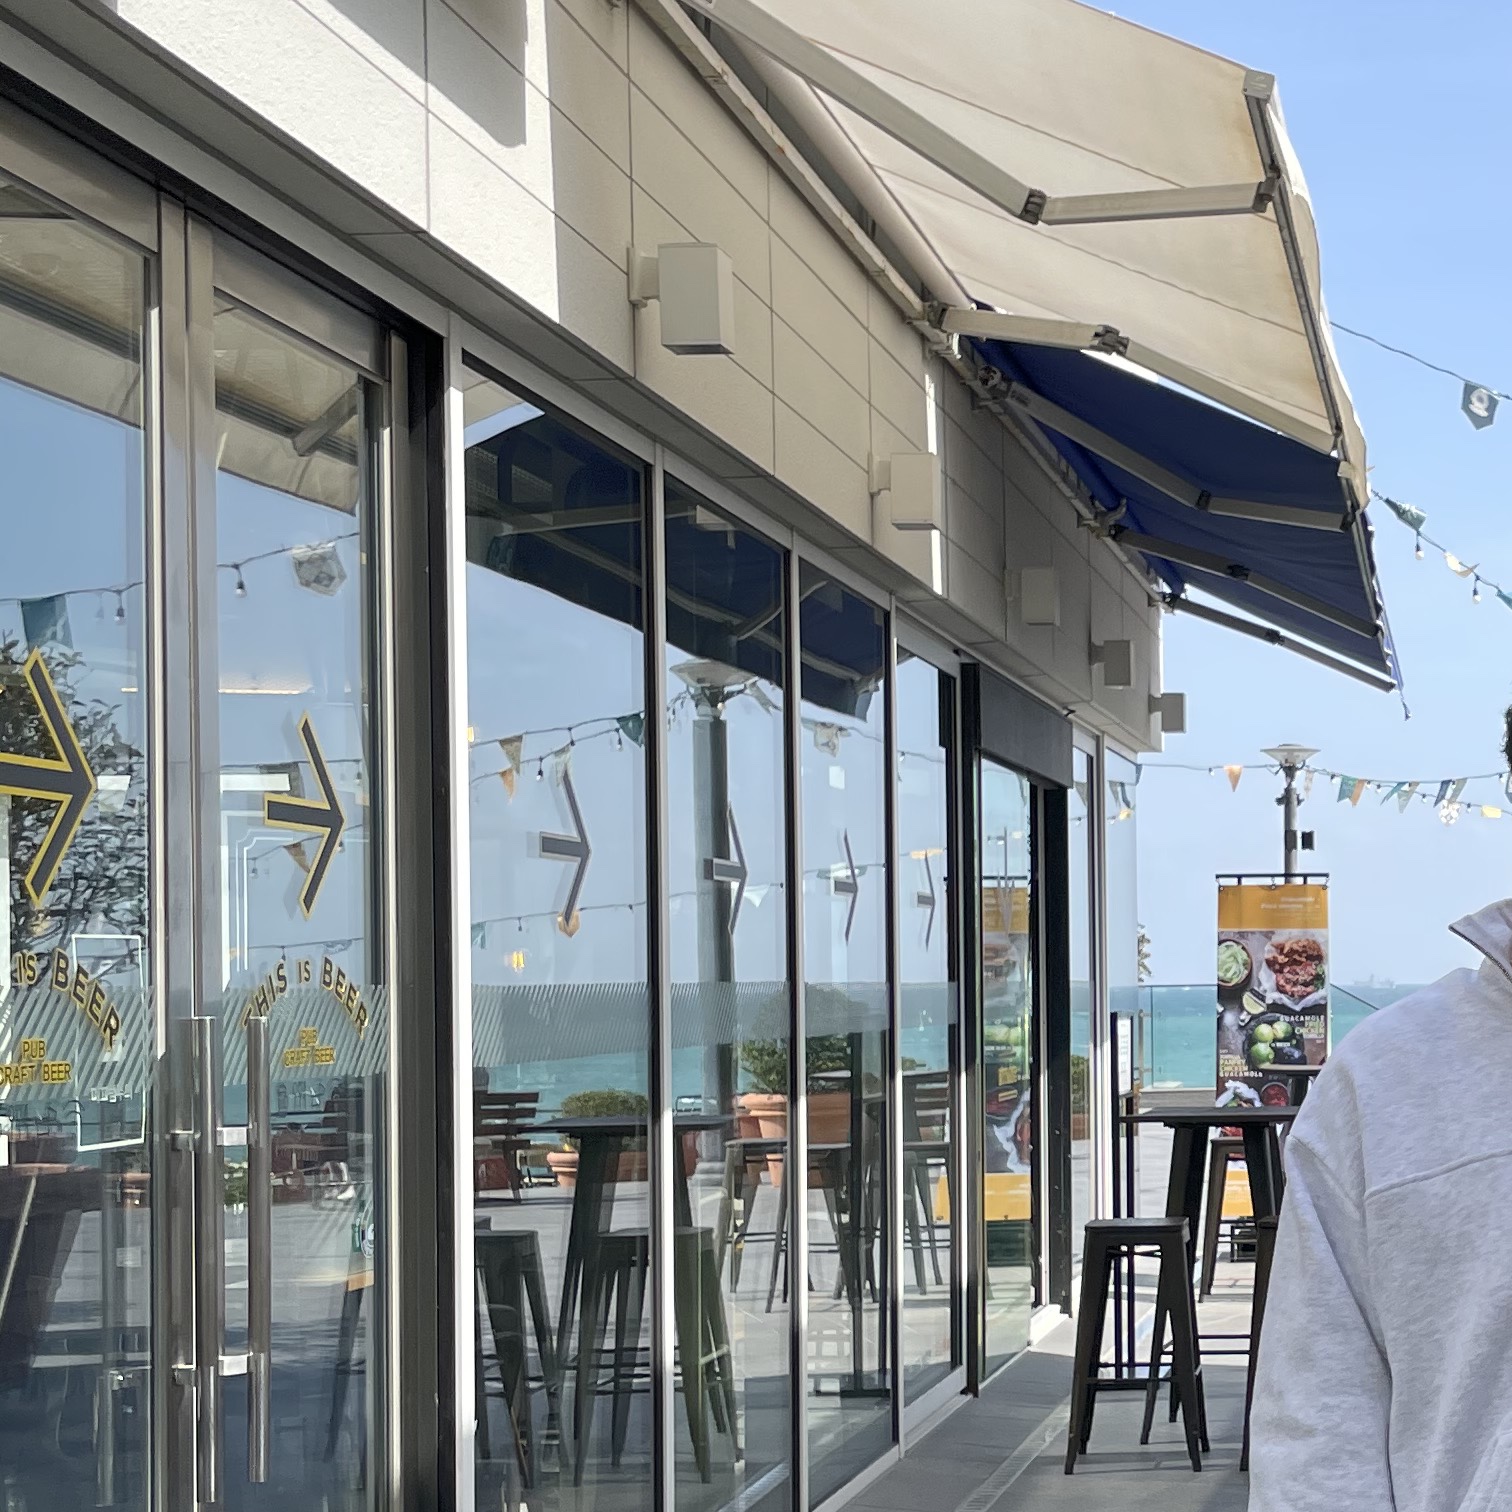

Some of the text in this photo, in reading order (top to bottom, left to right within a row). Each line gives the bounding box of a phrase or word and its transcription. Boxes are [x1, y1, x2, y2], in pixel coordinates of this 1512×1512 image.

[16, 948, 121, 1052] IS BEER
[297, 959, 311, 984] IS
[321, 955, 369, 1039] BEER
[21, 1039, 46, 1058] PUB
[42, 1062, 72, 1082] BEER
